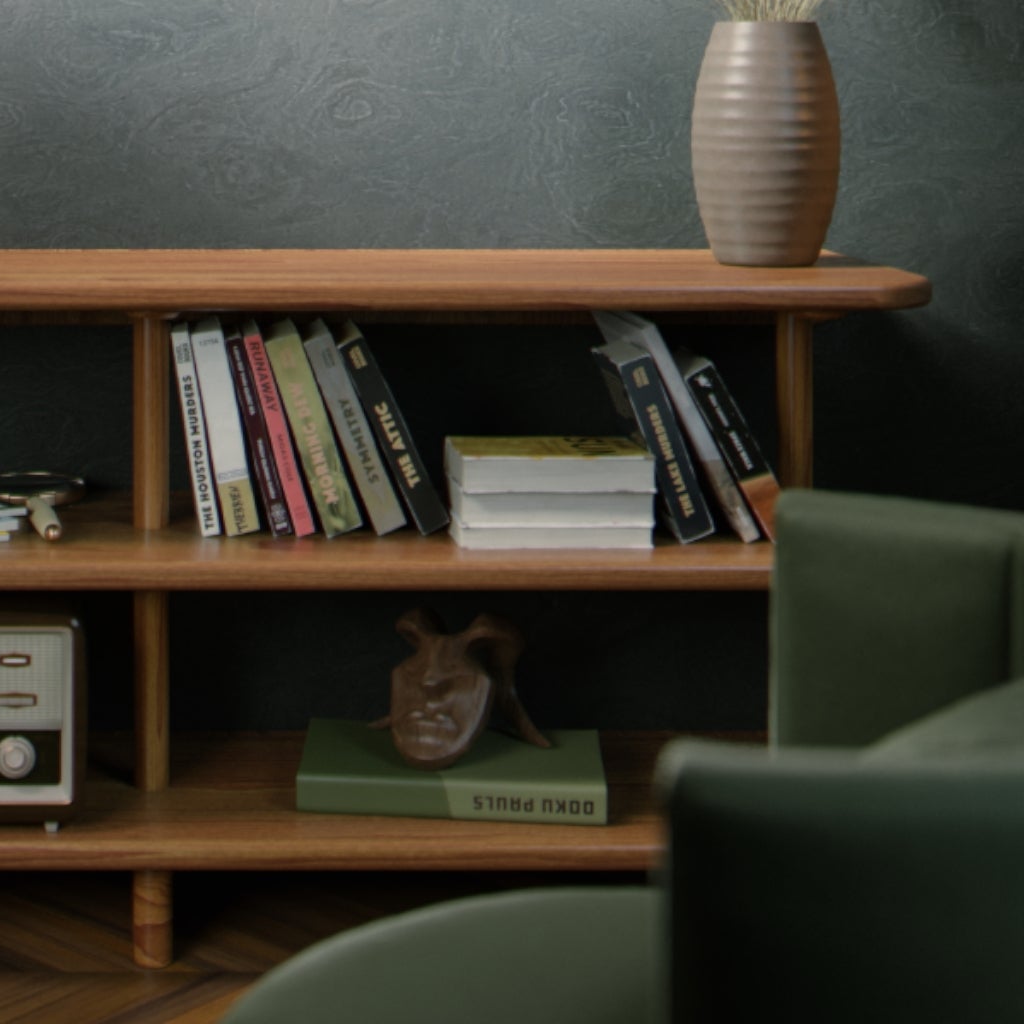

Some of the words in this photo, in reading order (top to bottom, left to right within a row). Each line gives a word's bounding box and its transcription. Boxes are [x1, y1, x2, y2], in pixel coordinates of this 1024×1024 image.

[249, 341, 278, 412] RUNAWAY
[182, 375, 202, 436] MURDERS
[289, 383, 311, 416] DEW
[339, 398, 378, 485] SYMMETRY
[374, 401, 407, 450] ATTIC
[646, 404, 675, 461] MURDERS
[192, 438, 210, 502] HOUSTON
[303, 420, 339, 504] MORNING
[397, 456, 421, 488] THE
[666, 459, 685, 493] LAKE
[203, 504, 215, 530] THE
[678, 492, 694, 518] THE
[473, 794, 534, 812] PAULS
[541, 799, 595, 815] DOKU
